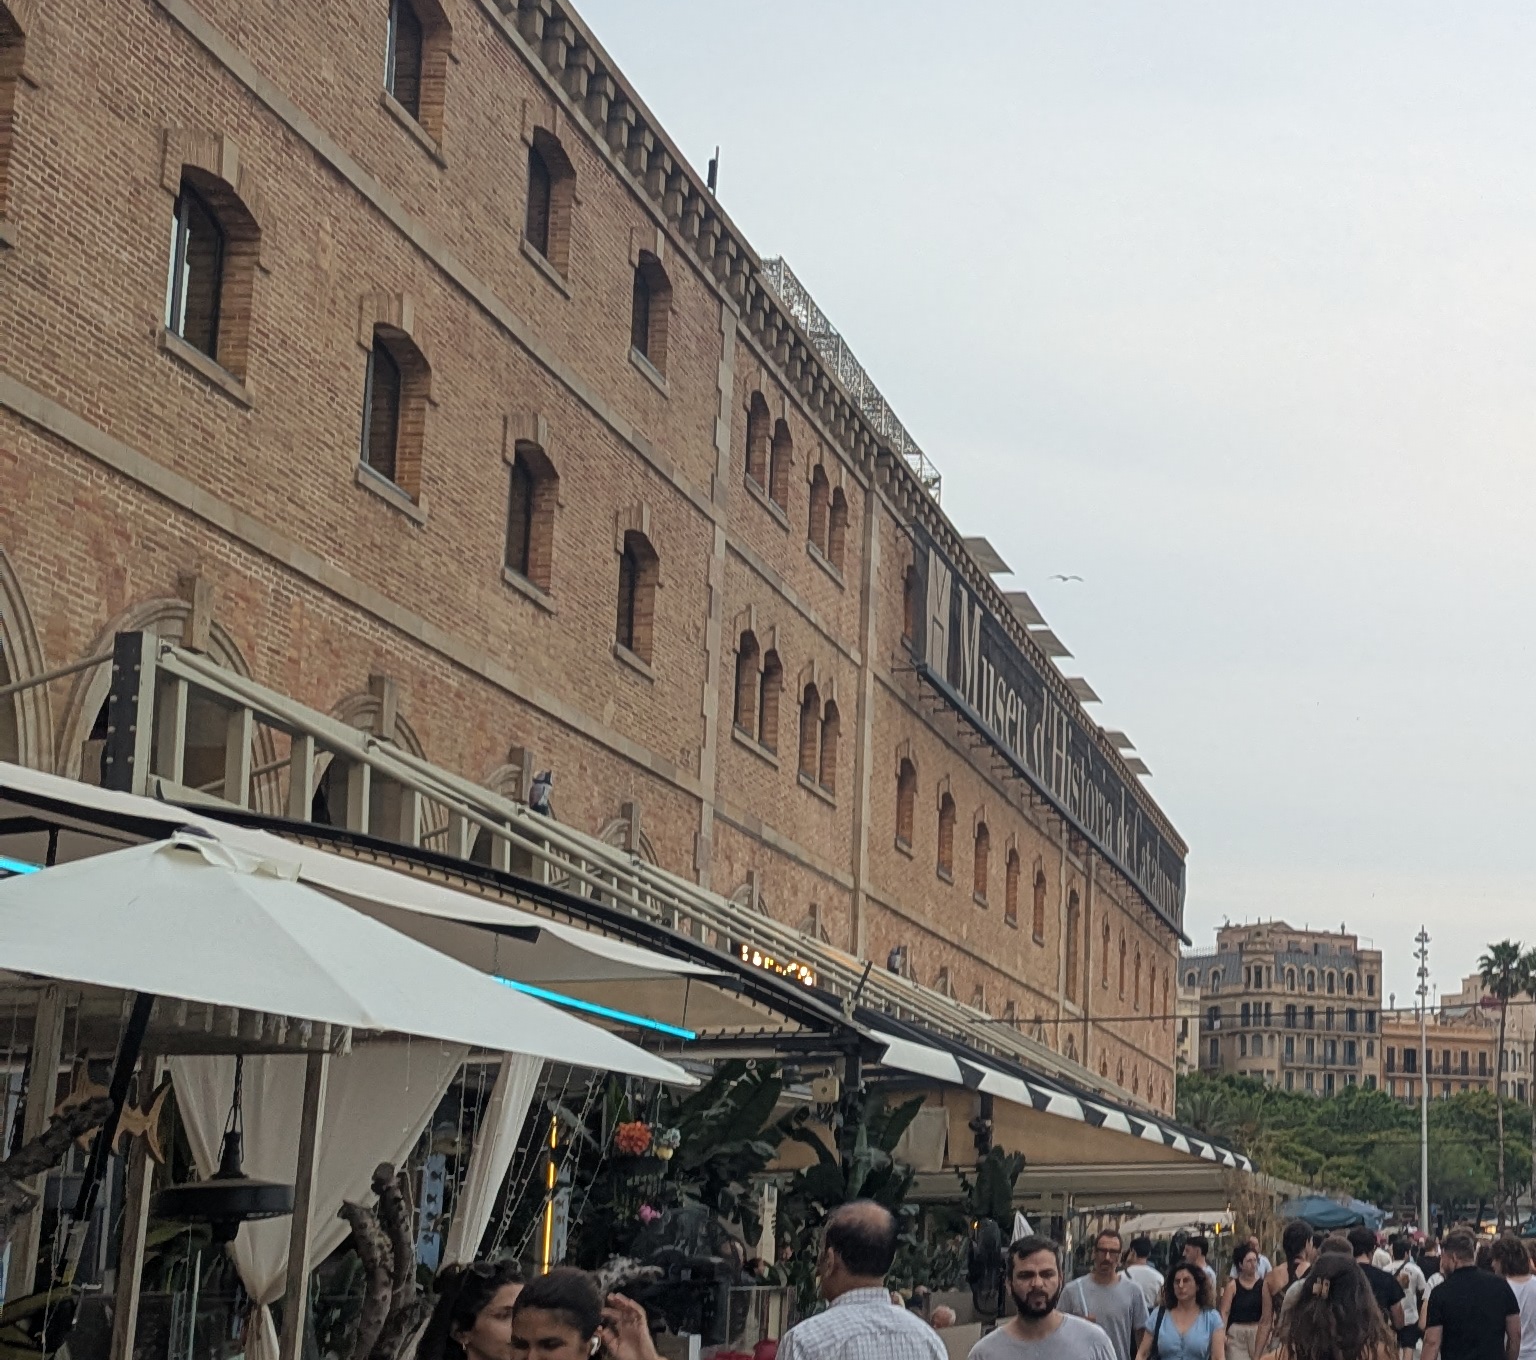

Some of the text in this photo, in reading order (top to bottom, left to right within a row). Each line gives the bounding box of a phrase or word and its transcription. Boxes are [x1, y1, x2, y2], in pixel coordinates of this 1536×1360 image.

[957, 583, 1029, 769] Museu
[1033, 686, 1114, 854] d'Història
[1117, 786, 1130, 871] de
